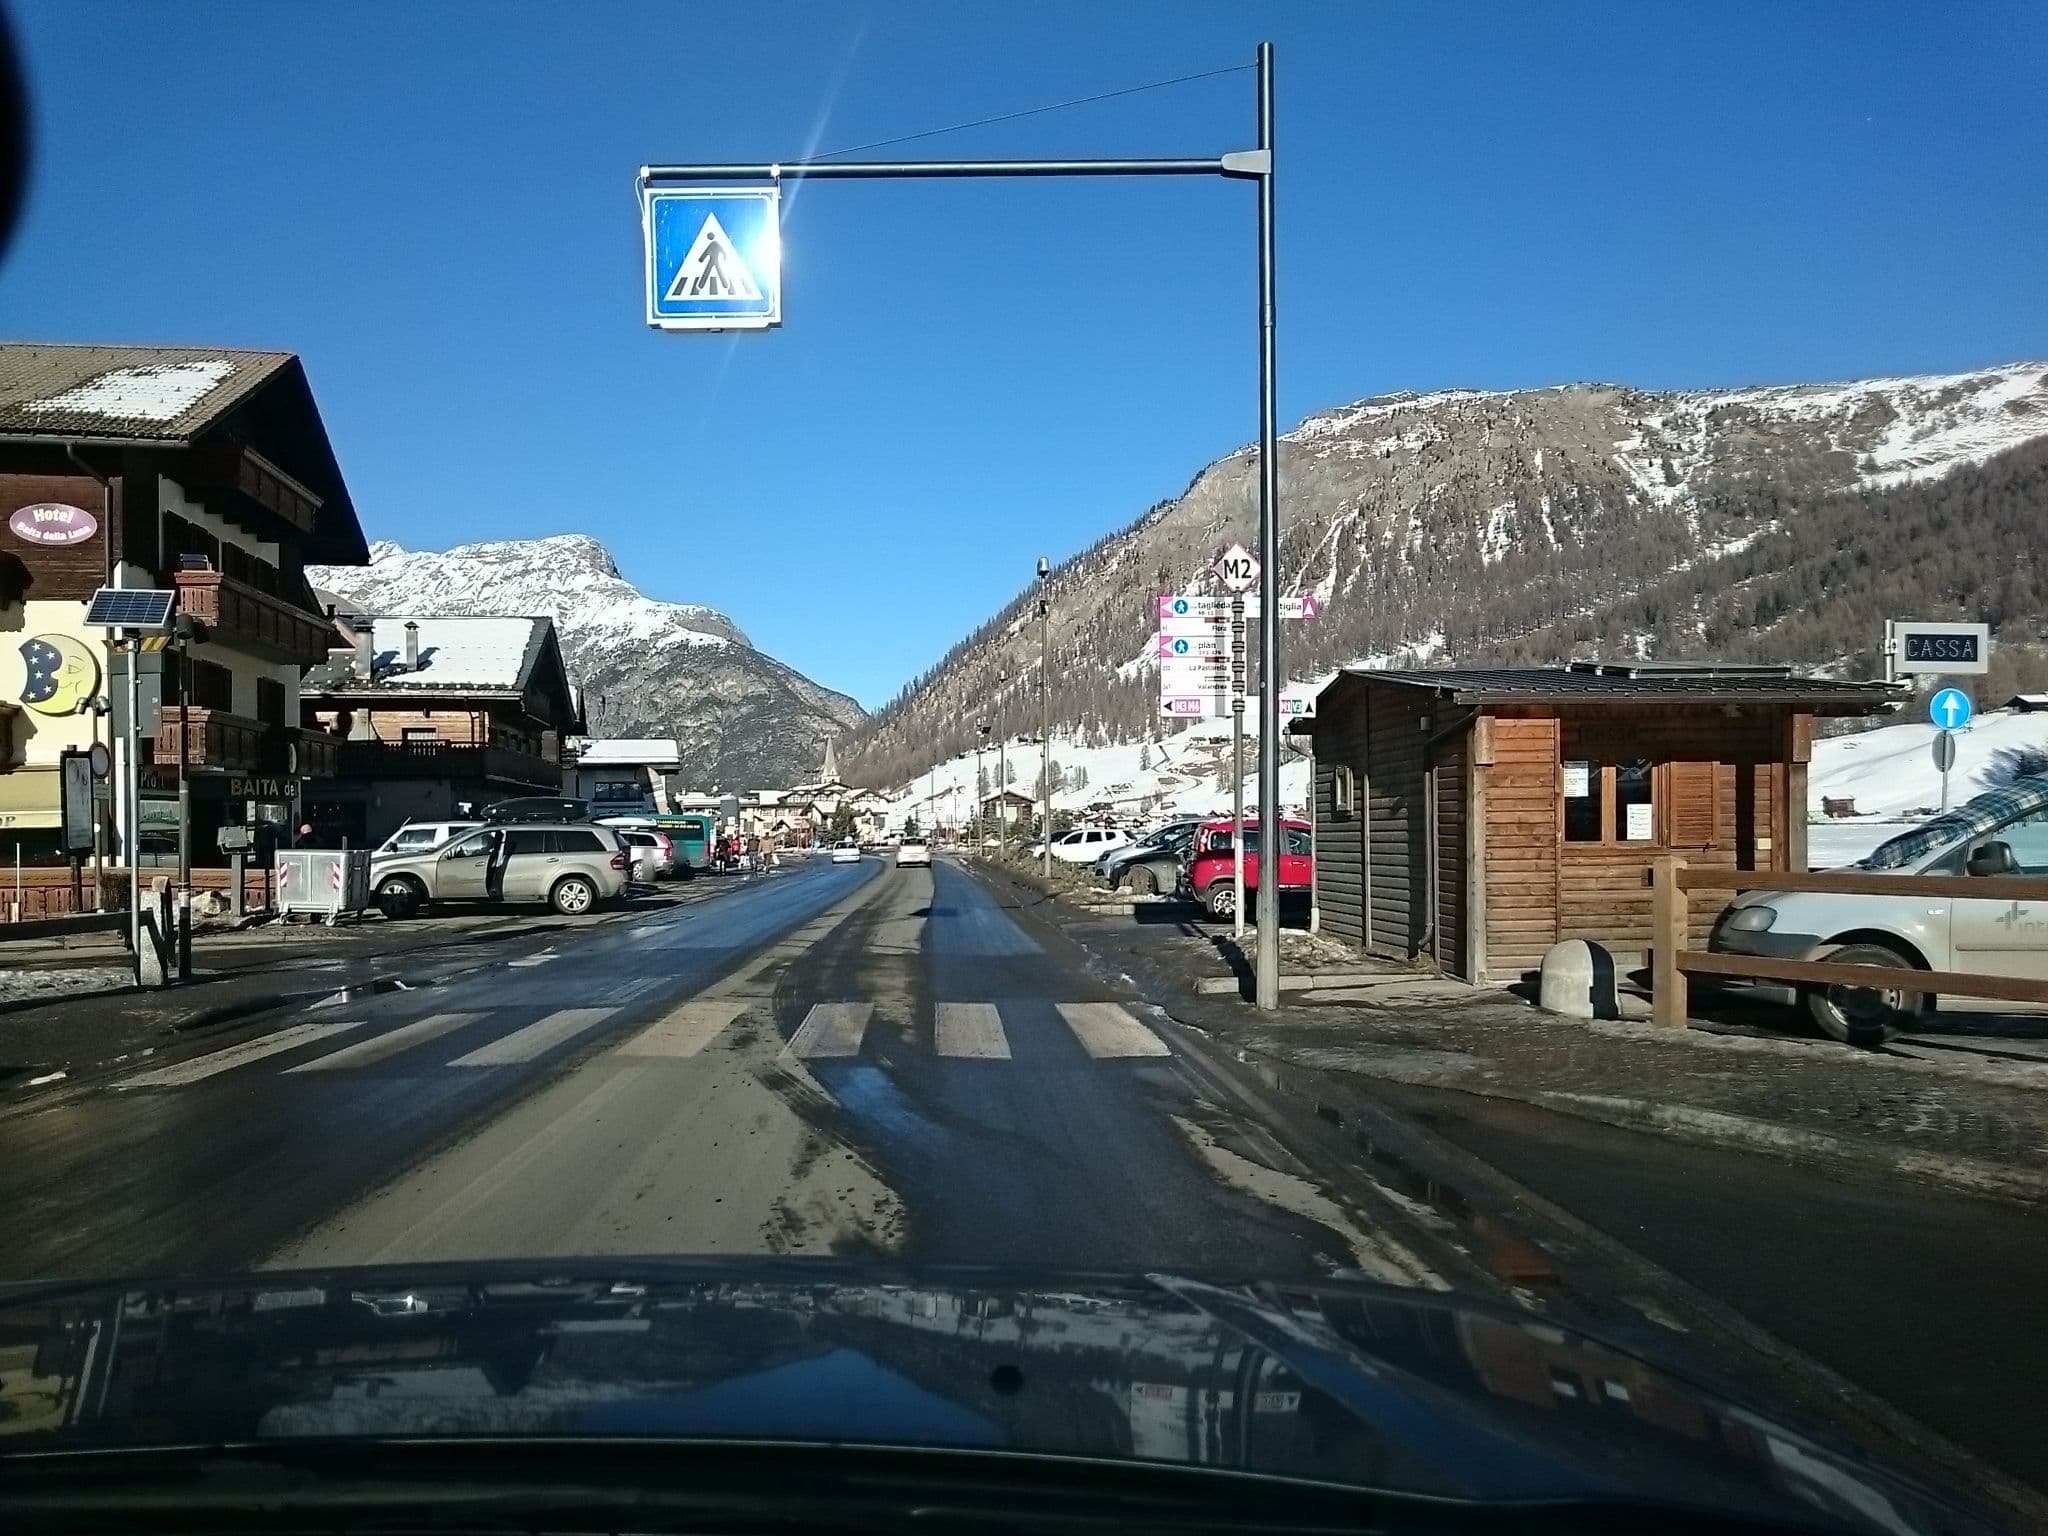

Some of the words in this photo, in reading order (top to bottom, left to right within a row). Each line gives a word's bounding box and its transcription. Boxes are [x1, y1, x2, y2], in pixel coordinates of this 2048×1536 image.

[32, 508, 74, 523] Hotel
[1223, 558, 1252, 579] M2
[1907, 639, 1974, 658] CASSA
[231, 778, 279, 796] BAITA
